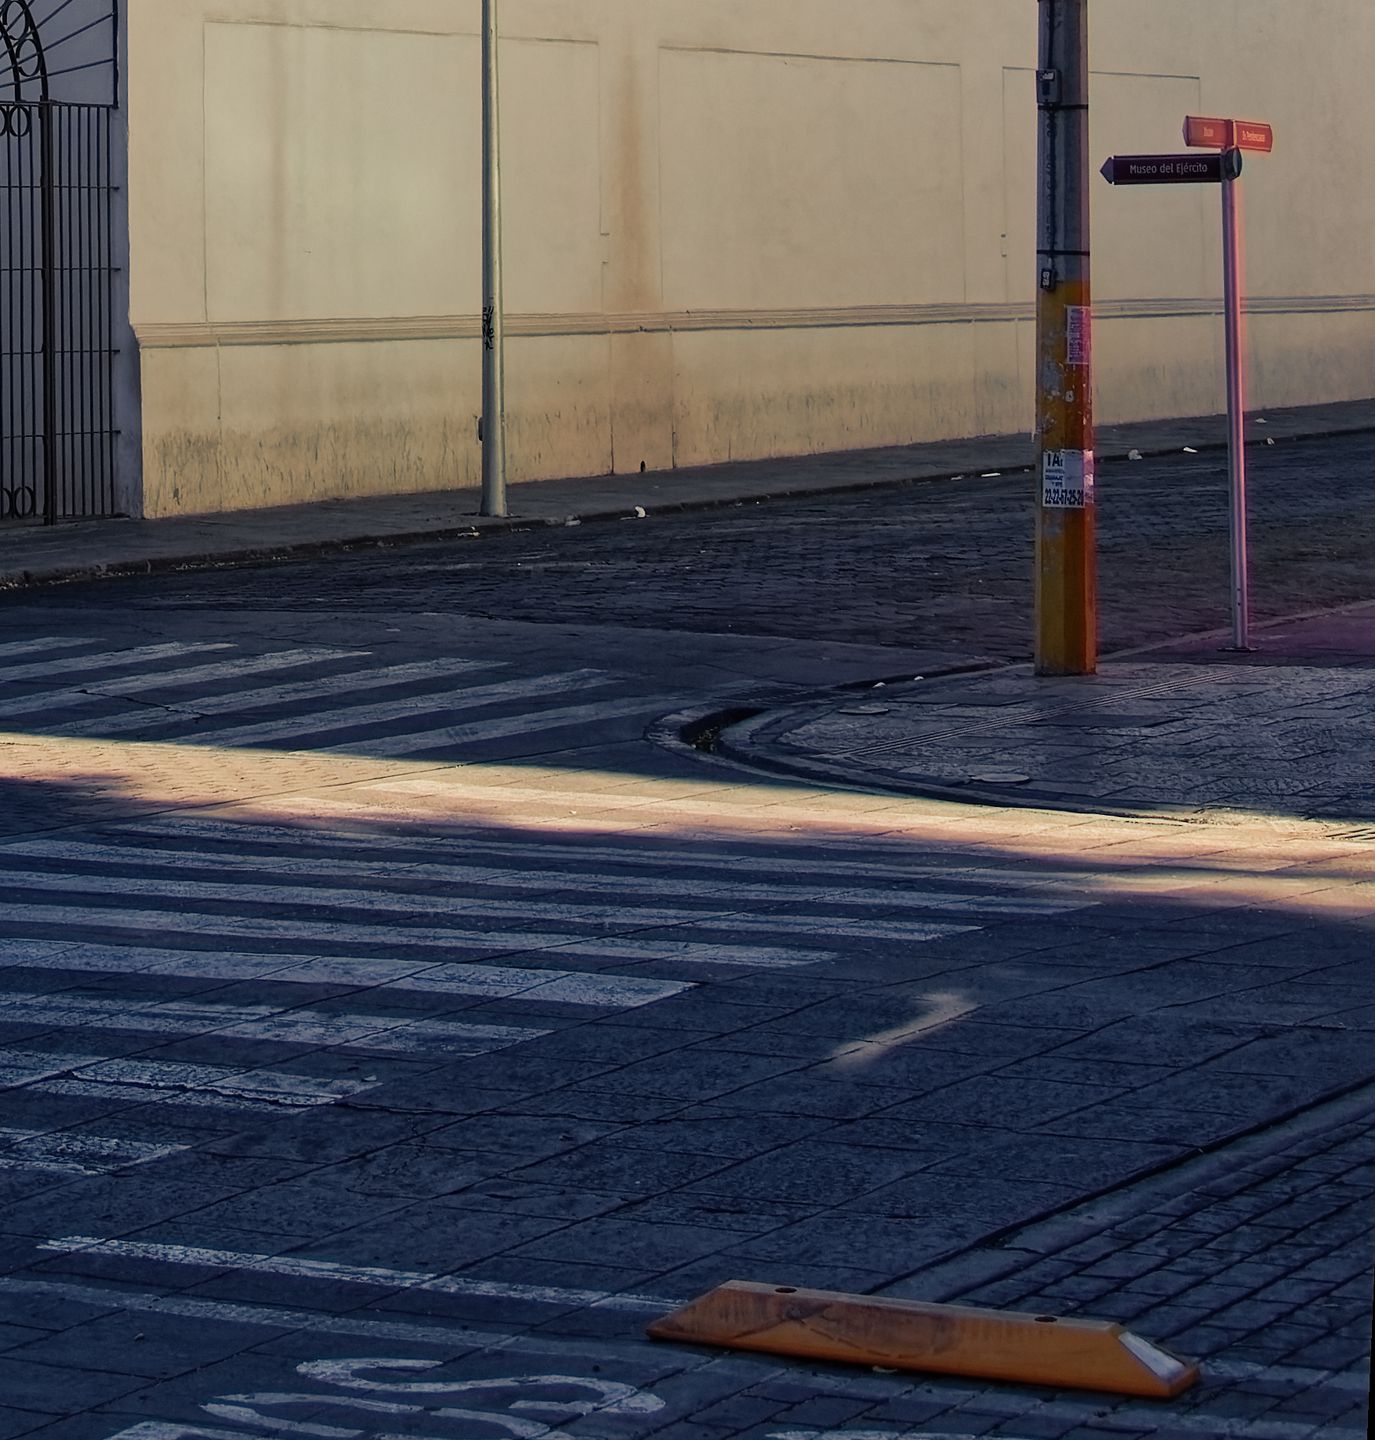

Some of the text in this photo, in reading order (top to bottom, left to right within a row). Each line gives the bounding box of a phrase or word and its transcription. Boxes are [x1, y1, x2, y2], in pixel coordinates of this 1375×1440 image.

[1129, 162, 1209, 176] Museo del Ejército
